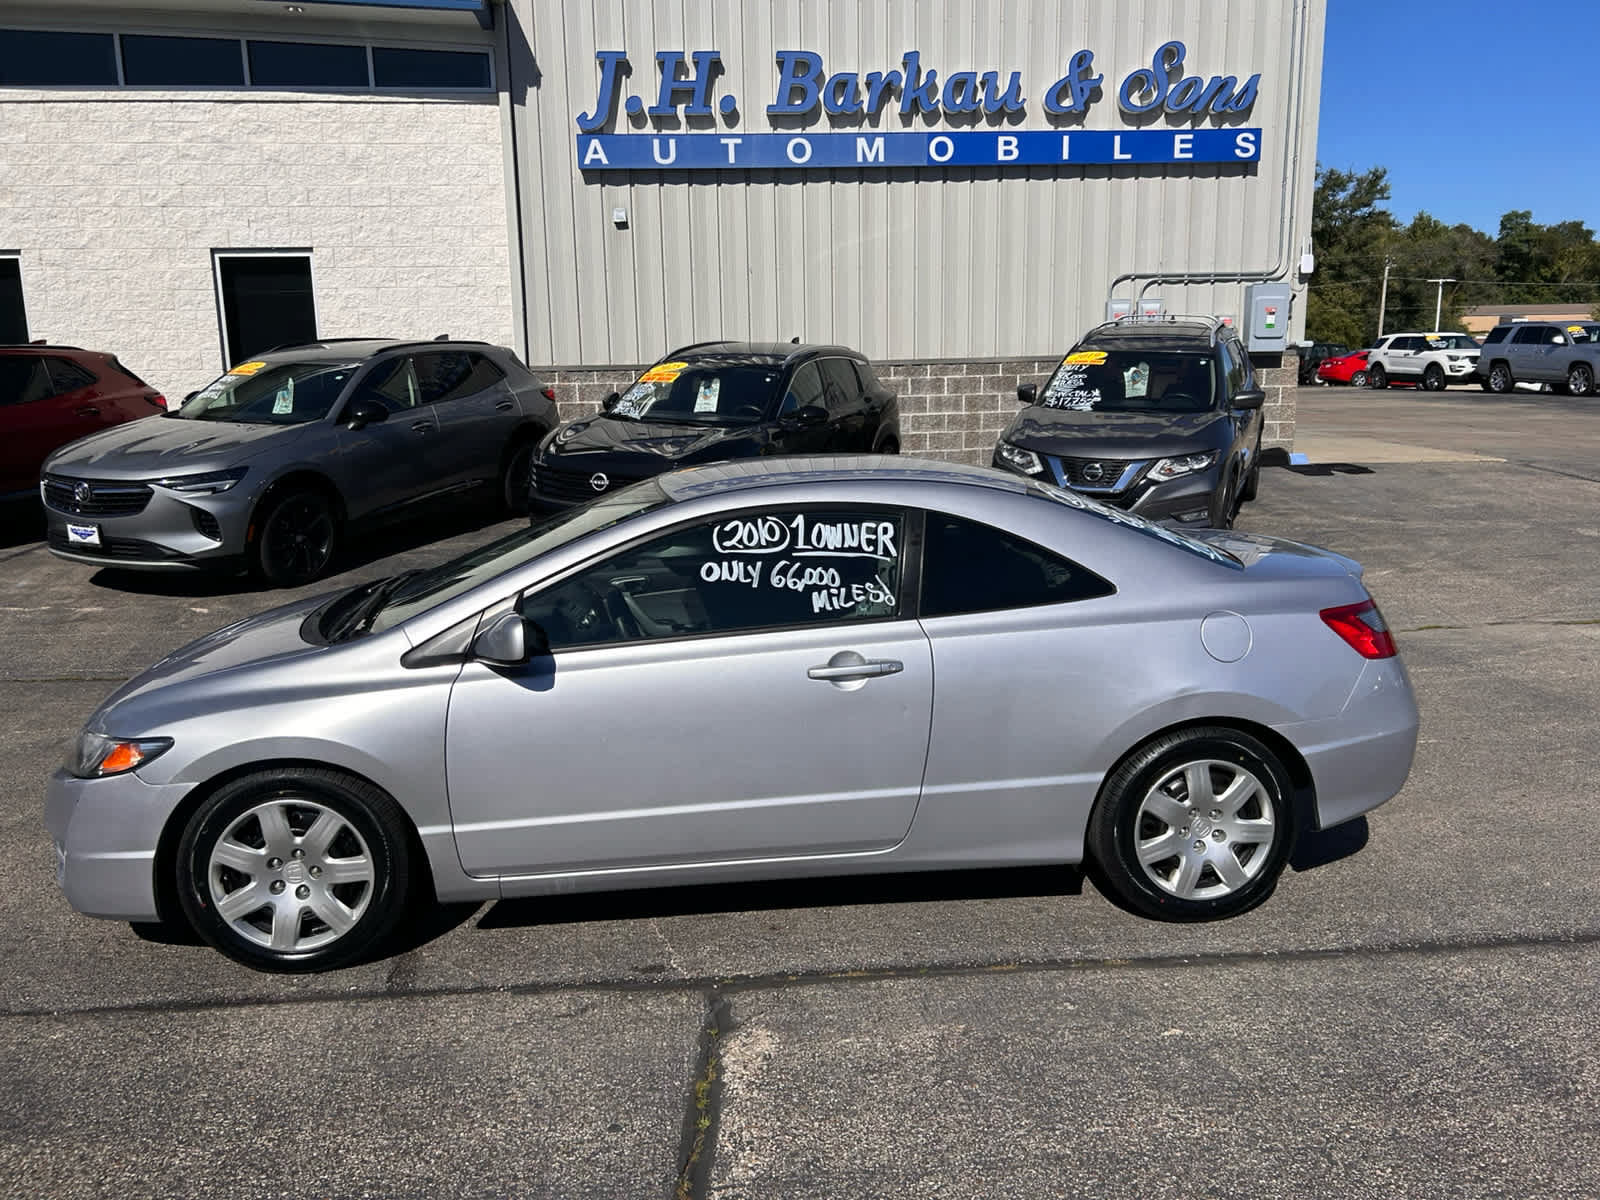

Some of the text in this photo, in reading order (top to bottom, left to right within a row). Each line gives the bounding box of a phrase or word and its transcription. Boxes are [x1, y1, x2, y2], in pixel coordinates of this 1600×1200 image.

[576, 40, 1262, 133] J.H. Barkau & Sons
[583, 132, 1256, 165] AUTOMOBILES
[790, 514, 812, 550] 1
[811, 521, 897, 557] OWNER
[700, 560, 841, 592] ONLY 66,000
